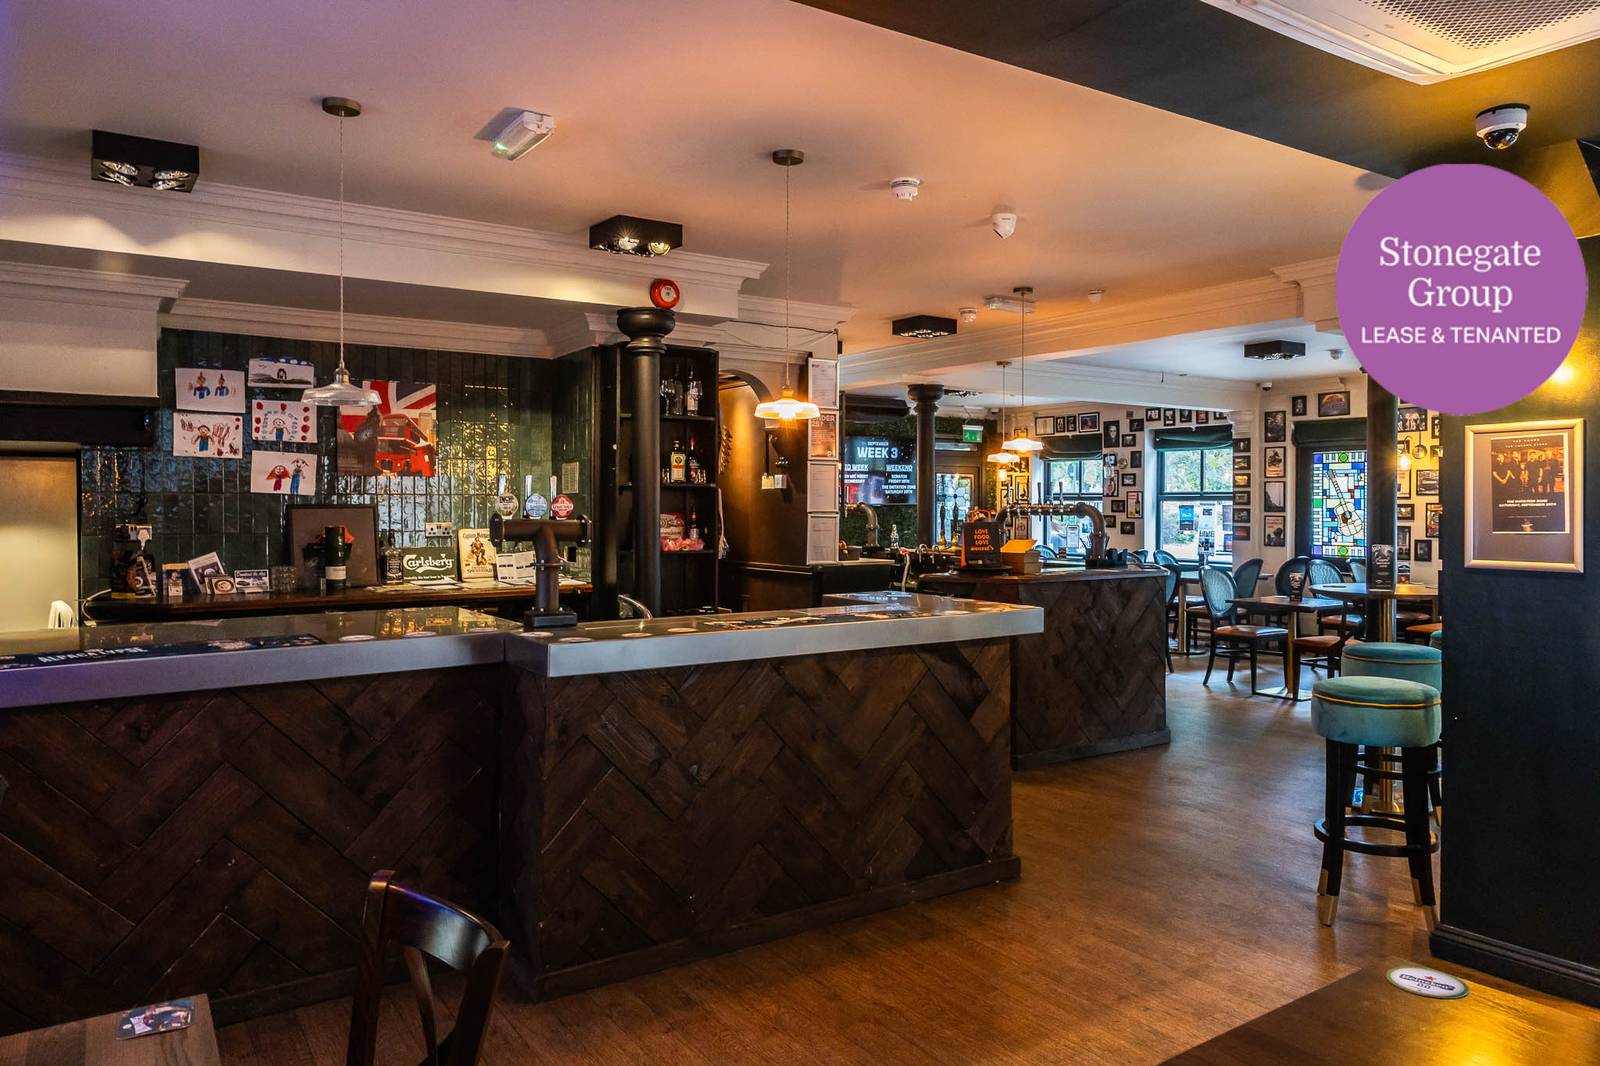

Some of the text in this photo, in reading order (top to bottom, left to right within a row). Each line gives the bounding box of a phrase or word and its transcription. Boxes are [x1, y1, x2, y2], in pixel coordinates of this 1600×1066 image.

[857, 447, 898, 458] WEEK 3
[403, 554, 454, 570] Carlsberg
